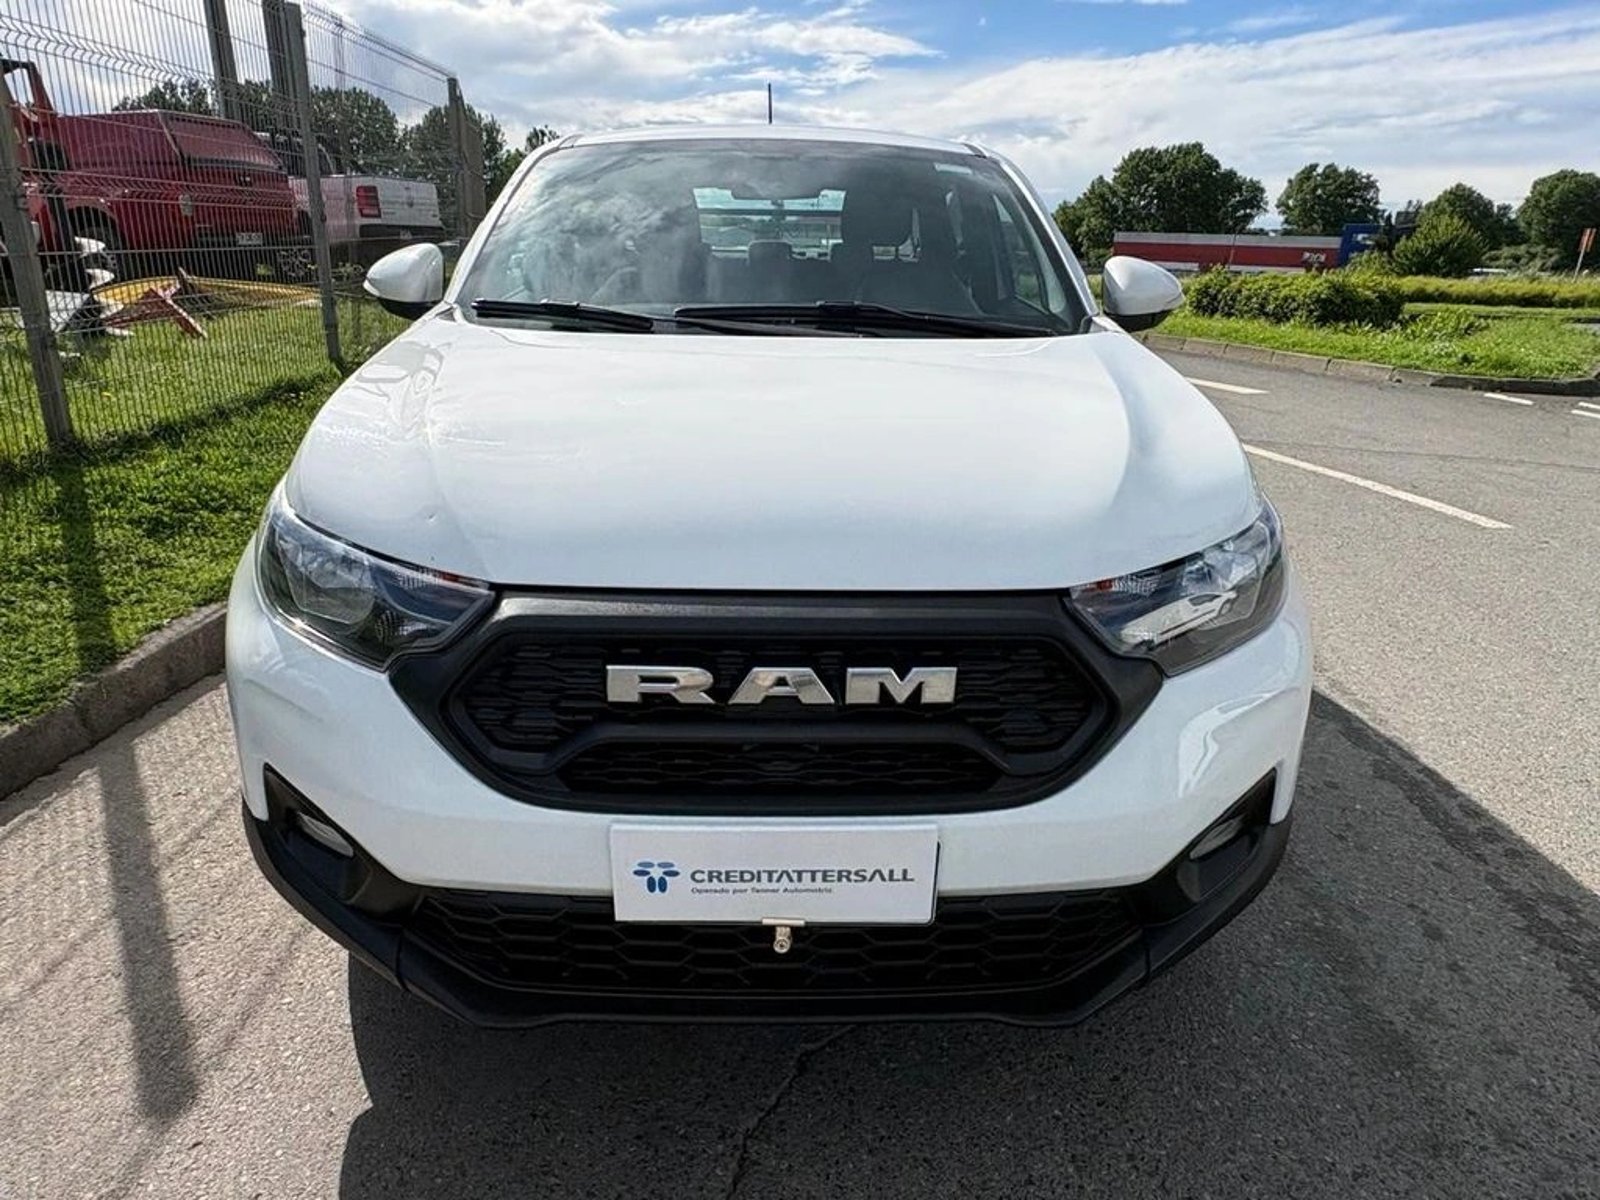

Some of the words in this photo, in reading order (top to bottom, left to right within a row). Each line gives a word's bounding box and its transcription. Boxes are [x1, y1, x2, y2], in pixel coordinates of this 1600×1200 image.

[606, 664, 958, 705] RAM
[690, 868, 914, 883] CREDITATTERSALL
[691, 887, 730, 895] Operado
